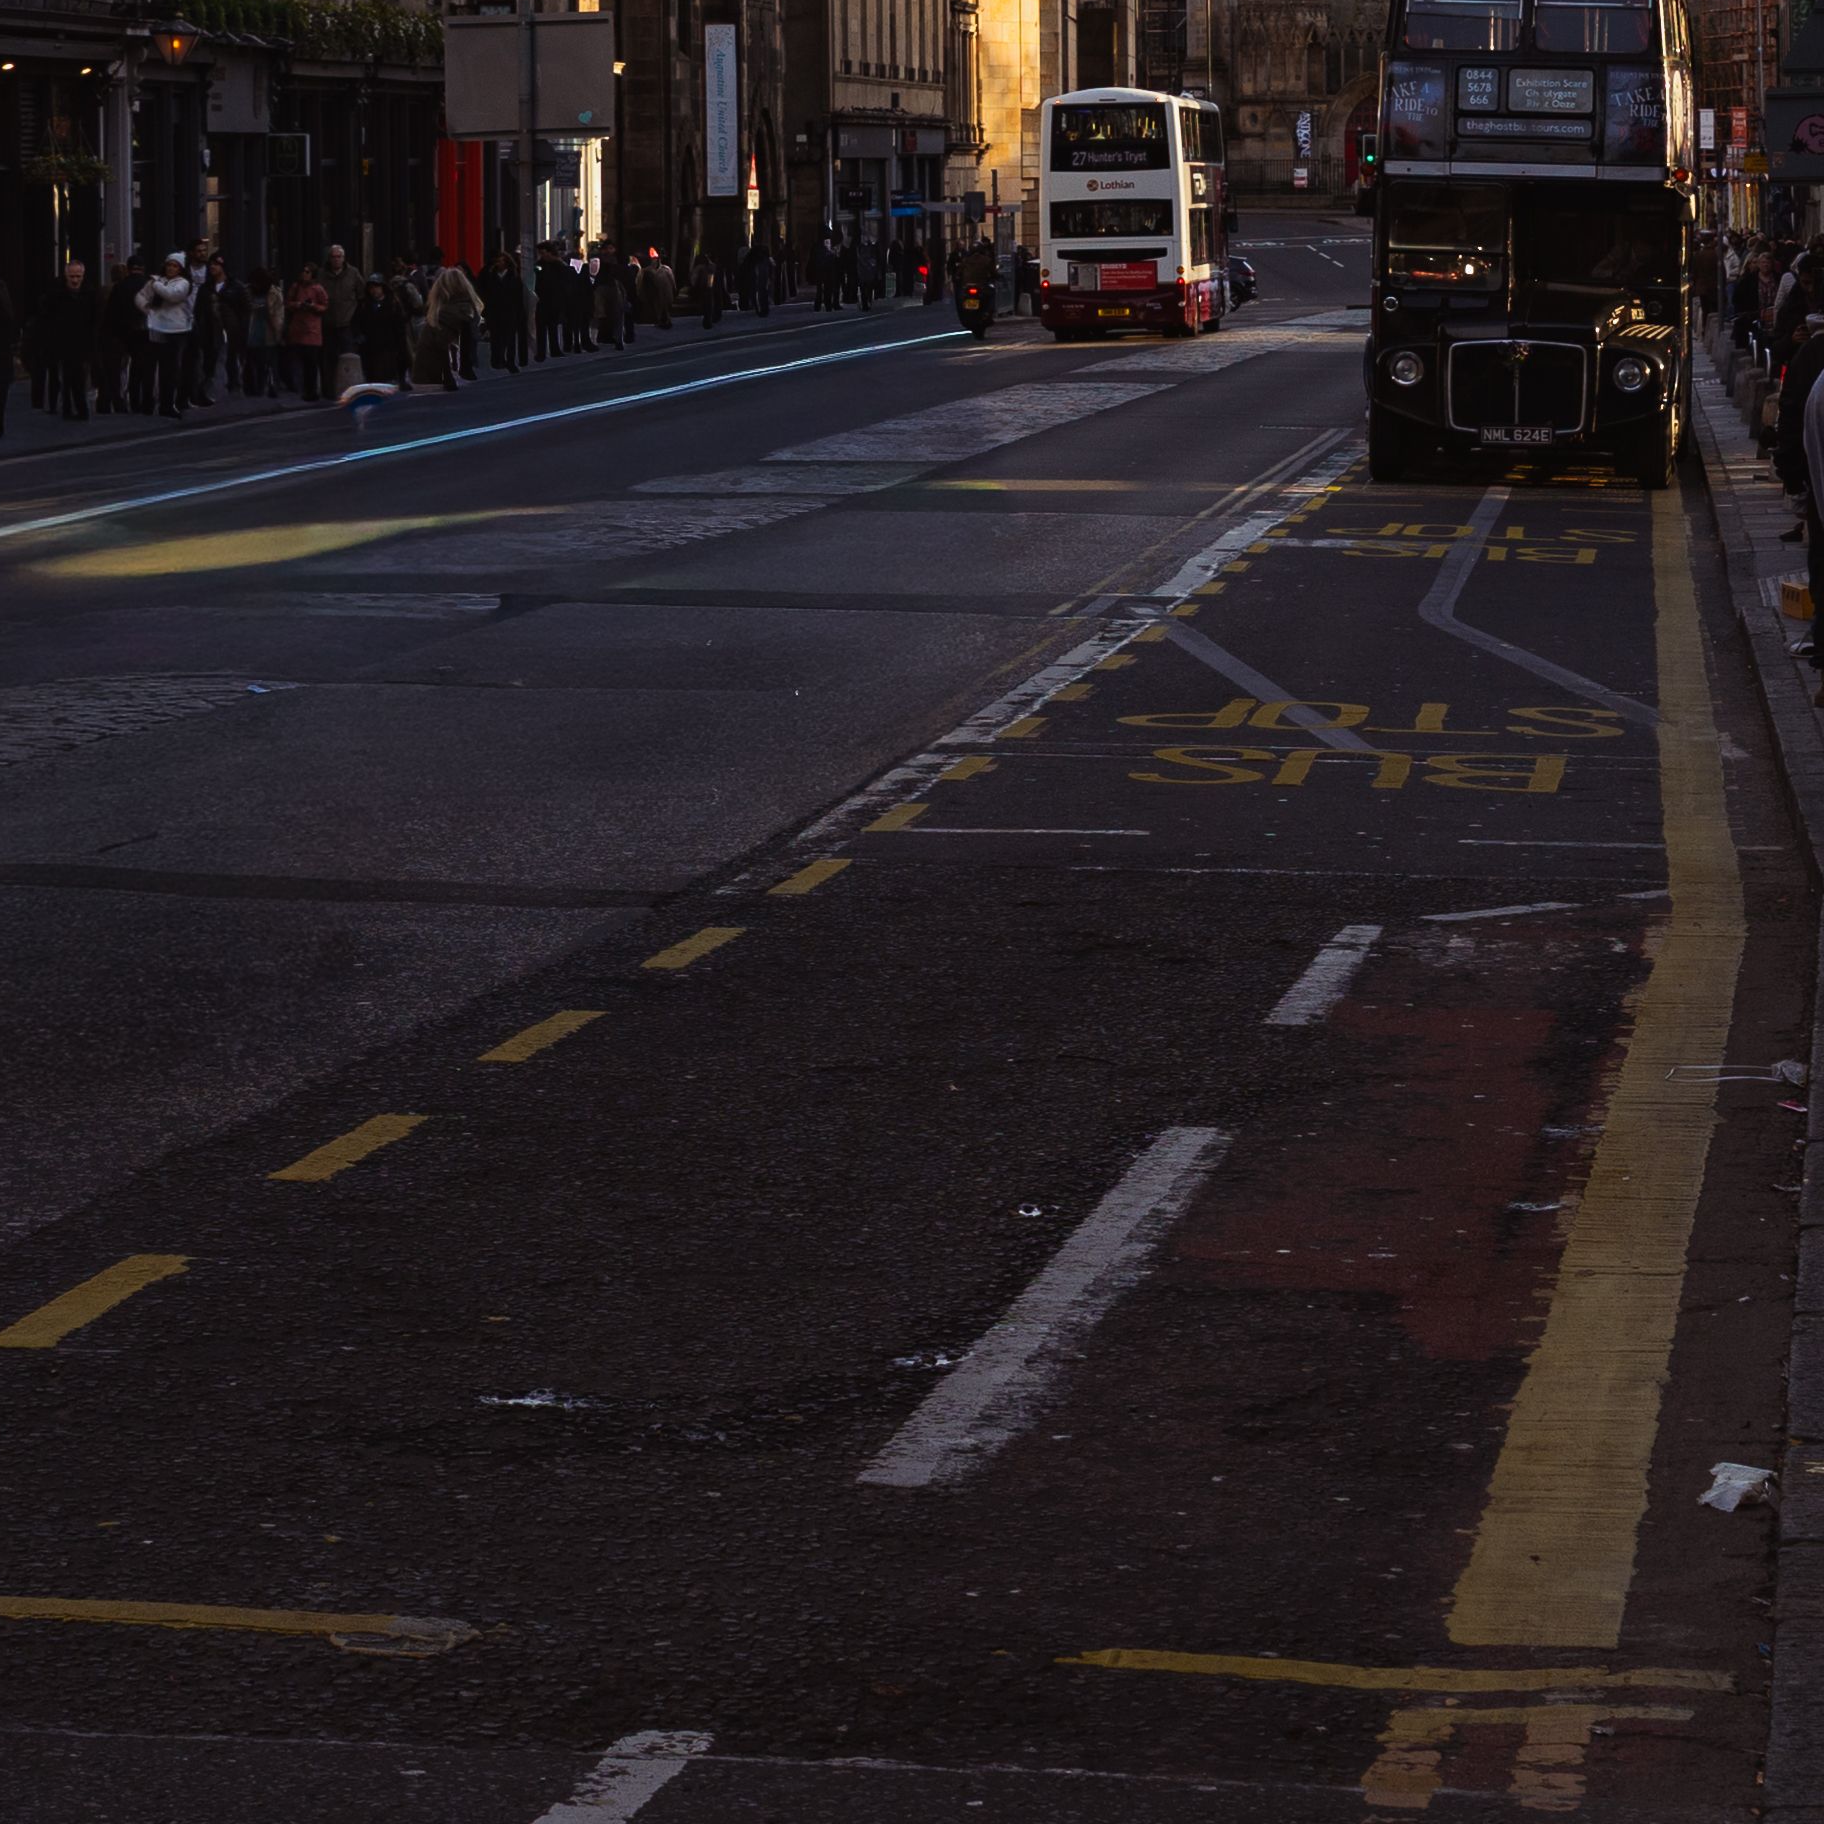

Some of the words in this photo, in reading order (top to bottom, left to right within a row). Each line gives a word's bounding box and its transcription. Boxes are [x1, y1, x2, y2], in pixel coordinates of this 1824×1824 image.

[716, 49, 727, 98] Augustine
[1466, 70, 1493, 80] 0844
[1467, 82, 1492, 93] 5678
[1516, 78, 1560, 87] Exhibition
[1563, 79, 1588, 88] Scare
[1394, 98, 1425, 112] RIDE
[1469, 95, 1489, 105] 666
[1552, 100, 1576, 109] Ooze
[717, 101, 728, 134] United
[1630, 104, 1660, 118] RIDE
[1466, 120, 1584, 133] theghostbutours.com
[718, 137, 729, 174] Church
[1072, 151, 1087, 166] 27
[1088, 152, 1122, 163] Hunter's
[1123, 151, 1147, 164] Tryst
[1100, 179, 1135, 190] Lothian
[1483, 428, 1510, 441] NML
[1513, 429, 1549, 442] 624E
[1115, 696, 1626, 739] STOP
[1127, 746, 1569, 794] BUS
